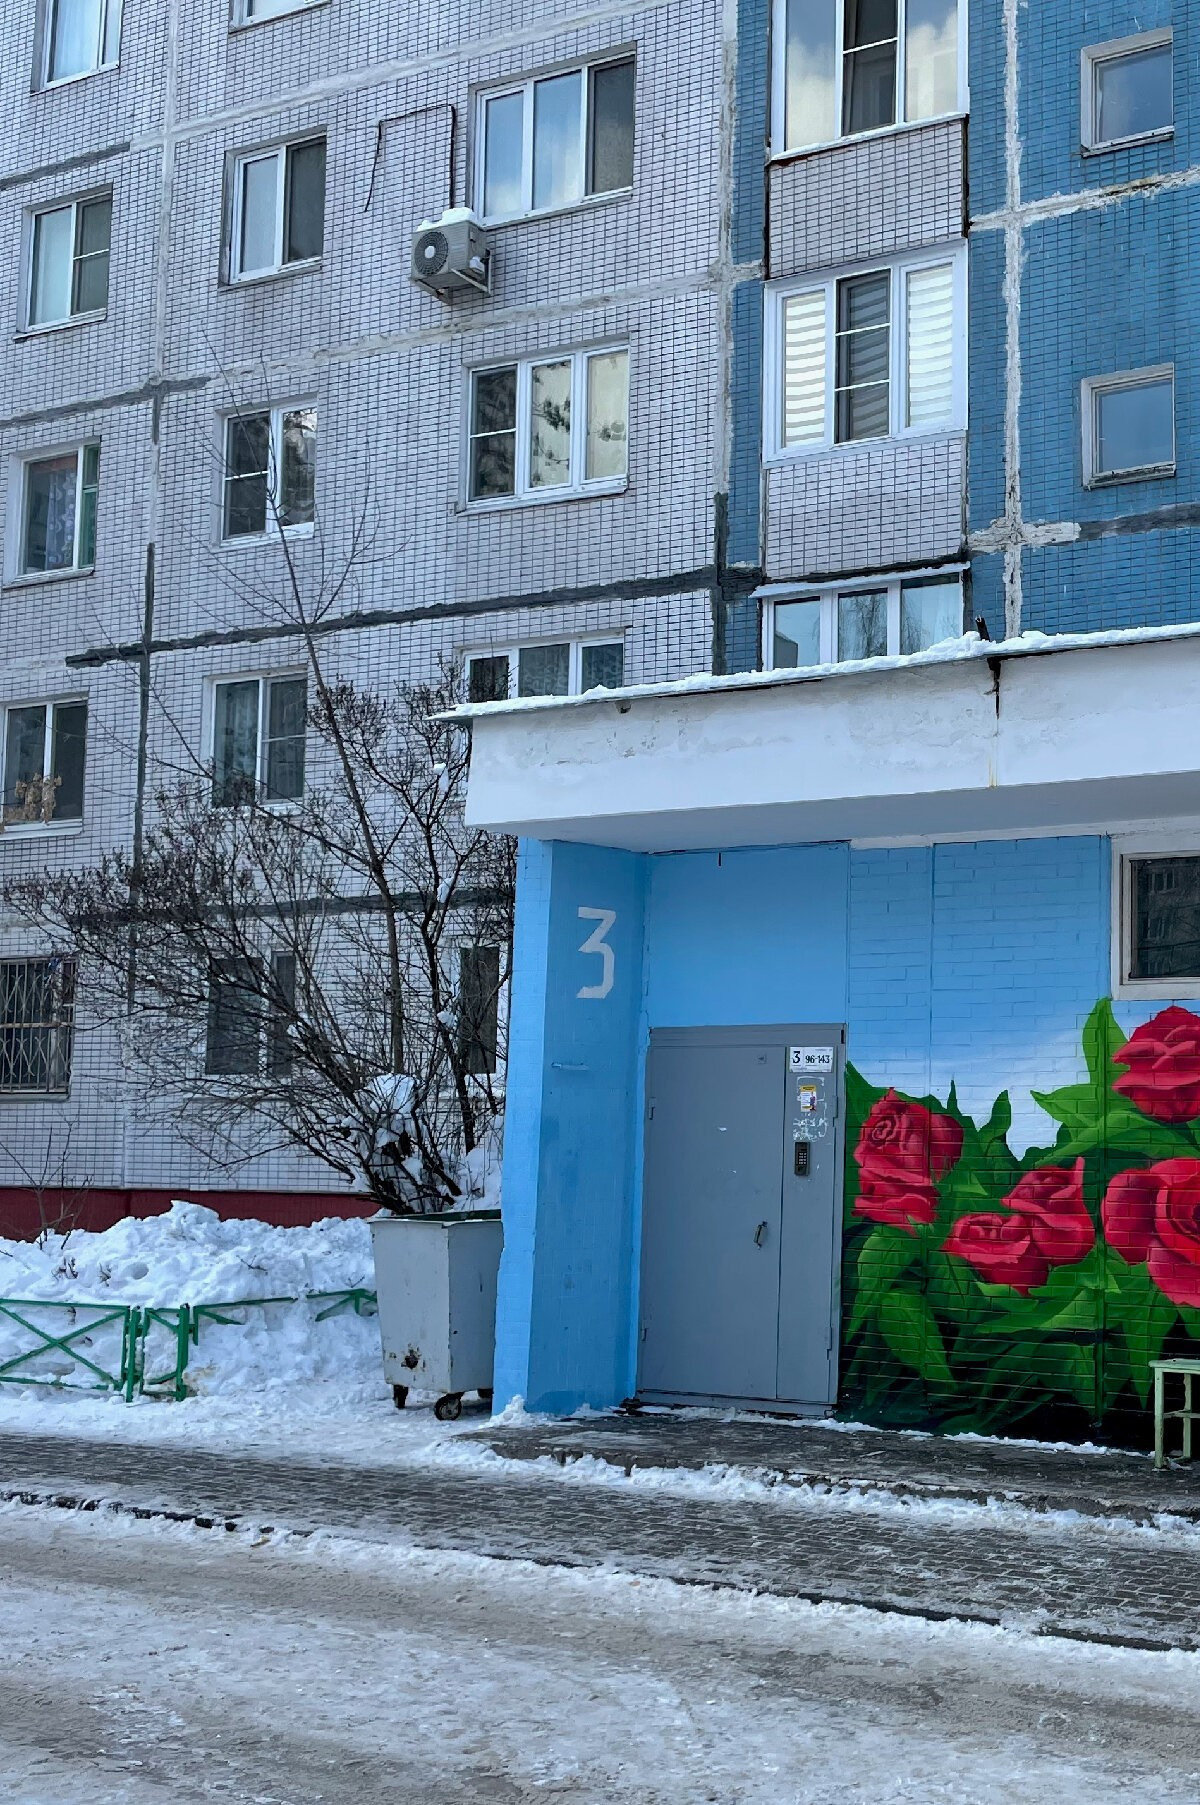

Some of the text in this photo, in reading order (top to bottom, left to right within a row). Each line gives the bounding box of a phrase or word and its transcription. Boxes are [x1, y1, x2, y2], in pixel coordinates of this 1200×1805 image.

[576, 906, 617, 999] 3
[792, 1050, 830, 1064] 3 96-143
